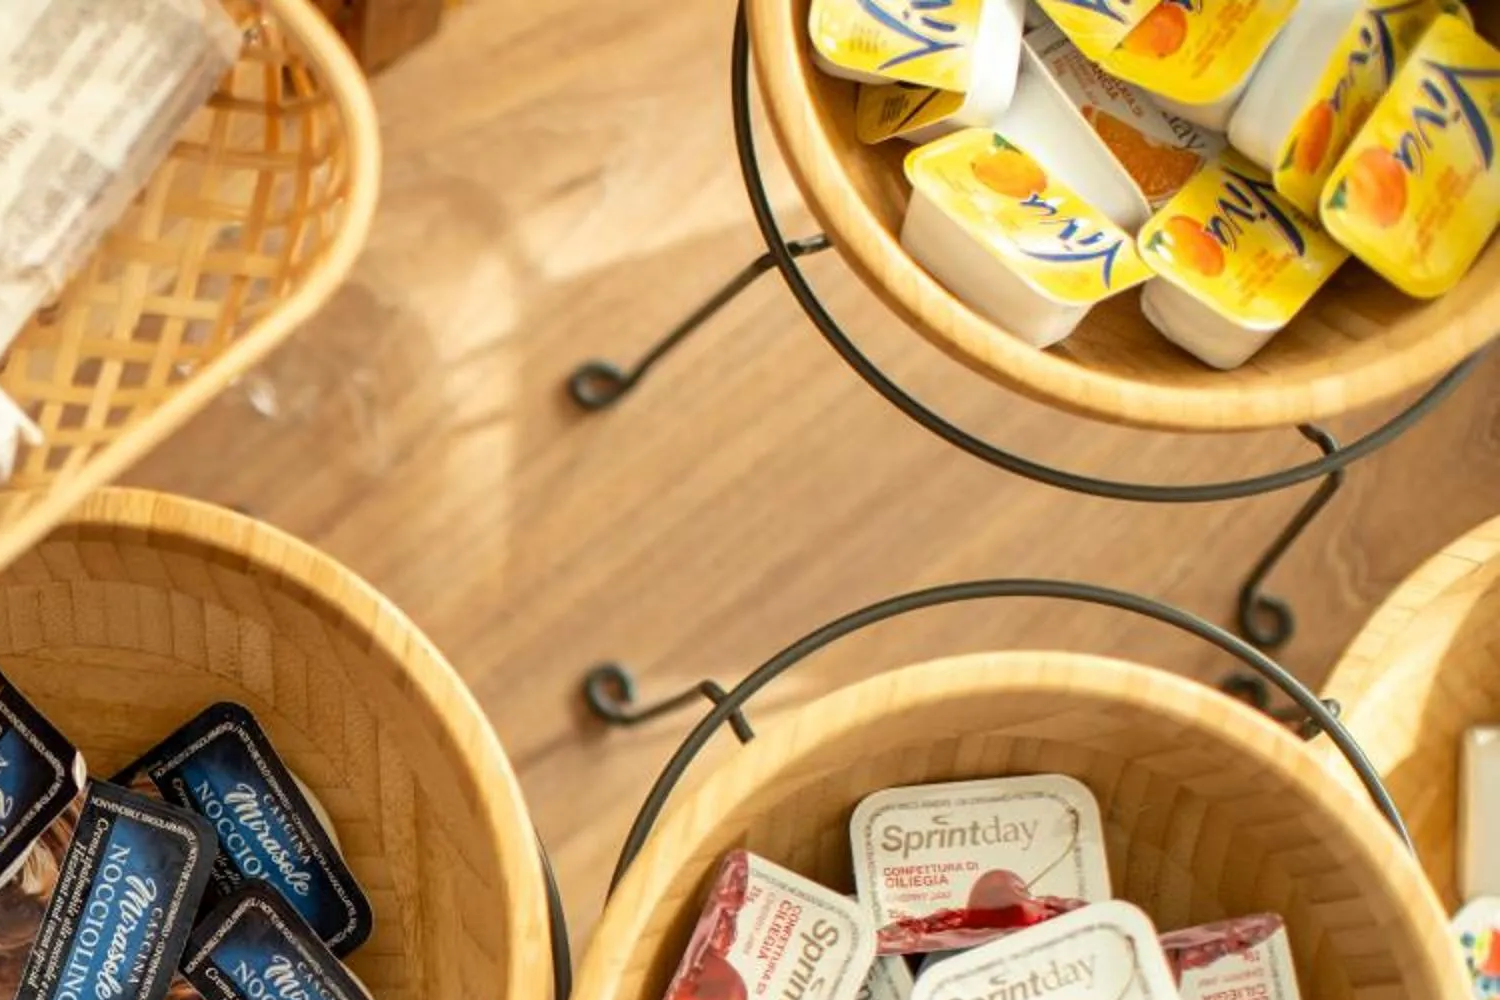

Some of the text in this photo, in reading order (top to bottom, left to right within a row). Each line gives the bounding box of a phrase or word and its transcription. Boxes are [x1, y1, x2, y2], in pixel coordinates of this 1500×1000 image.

[1392, 58, 1500, 172] Viva
[1206, 167, 1305, 257] Viva
[225, 783, 311, 896] Mirasole
[264, 794, 311, 864] CASCINA
[881, 816, 1037, 858] Sprintday
[885, 873, 948, 888] CILIEGIA
[95, 875, 157, 1000] Mirasole
[128, 907, 163, 983] CASCINA
